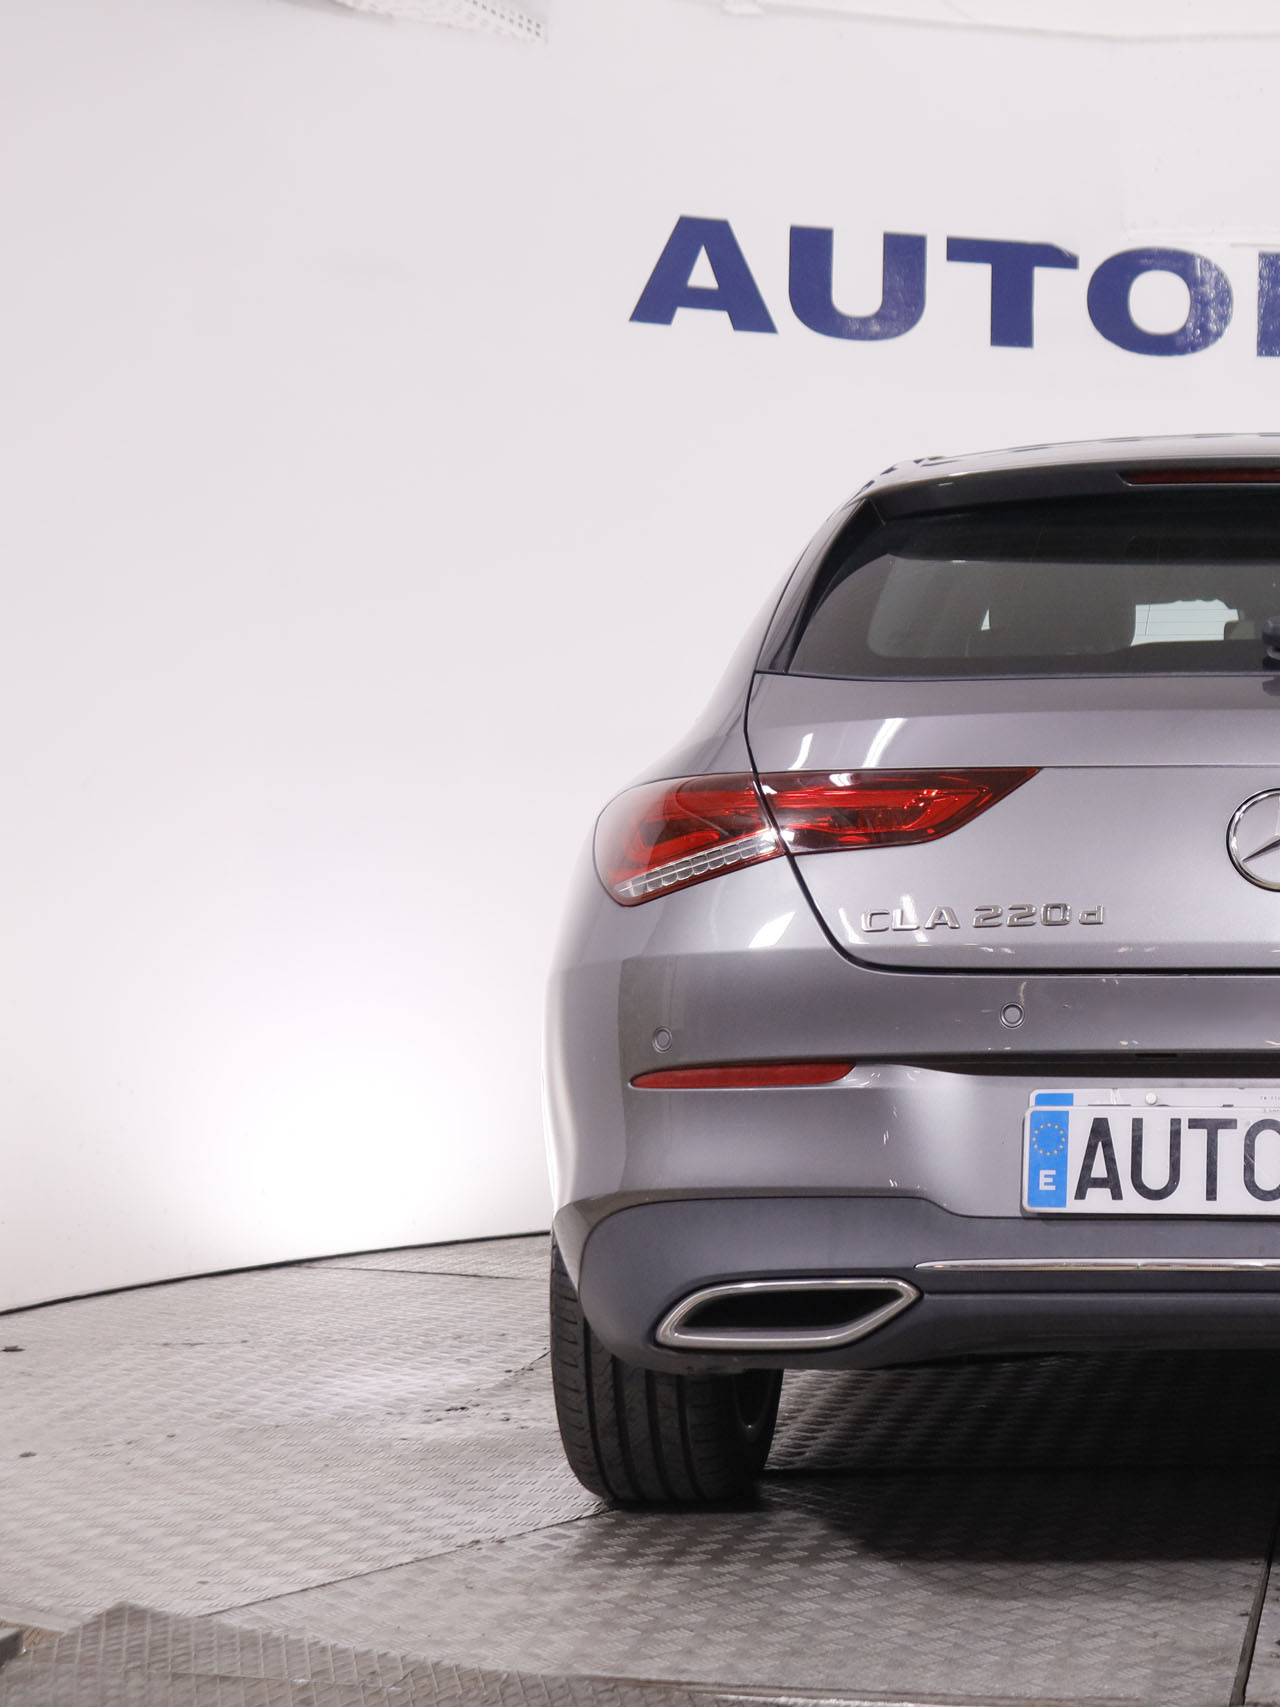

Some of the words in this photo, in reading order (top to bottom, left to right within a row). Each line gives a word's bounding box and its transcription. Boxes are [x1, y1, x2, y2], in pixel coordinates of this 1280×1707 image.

[860, 905, 960, 932] CLA
[972, 902, 1072, 928] 220
[1078, 904, 1105, 925] d
[1039, 1169, 1057, 1191] E
